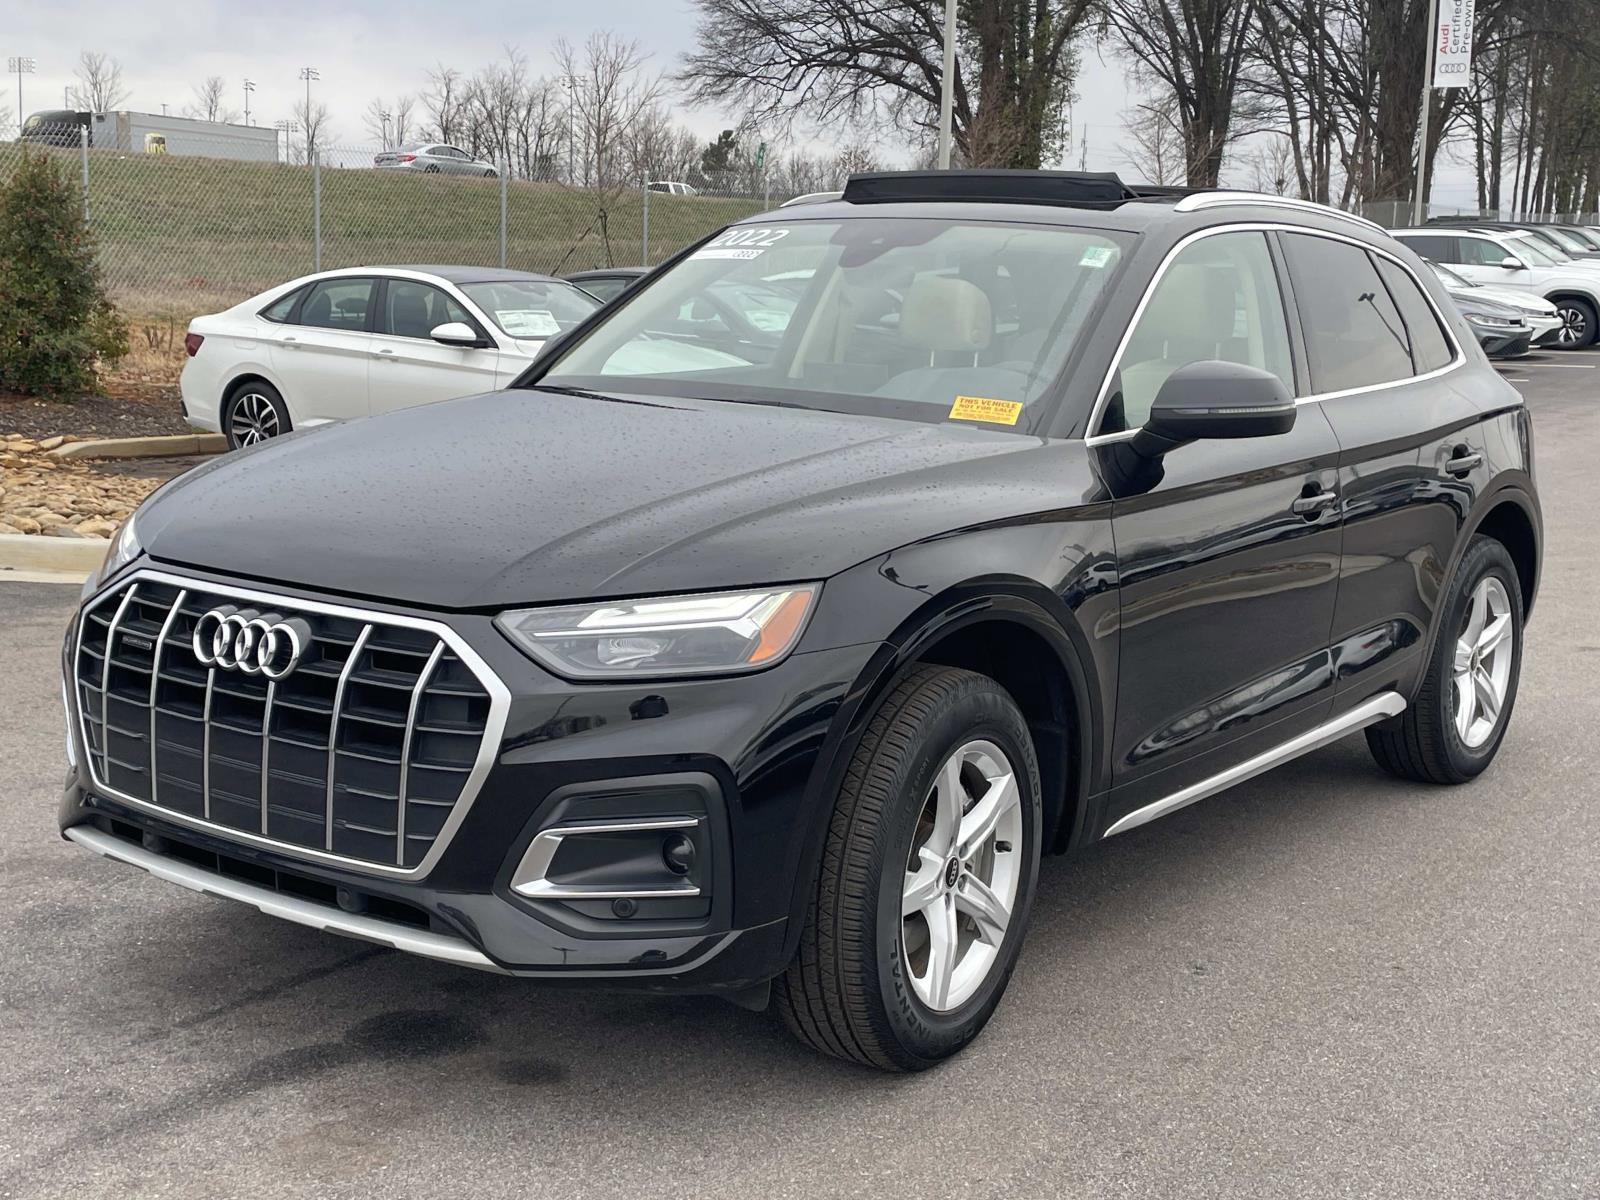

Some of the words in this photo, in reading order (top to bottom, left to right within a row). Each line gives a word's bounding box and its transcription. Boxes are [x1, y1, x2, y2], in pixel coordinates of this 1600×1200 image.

[1440, 24, 1450, 54] Audi
[1450, 0, 1463, 54] Certified
[706, 229, 790, 248] 2022
[959, 397, 979, 406] THIS
[981, 399, 1018, 410] VEHICLE
